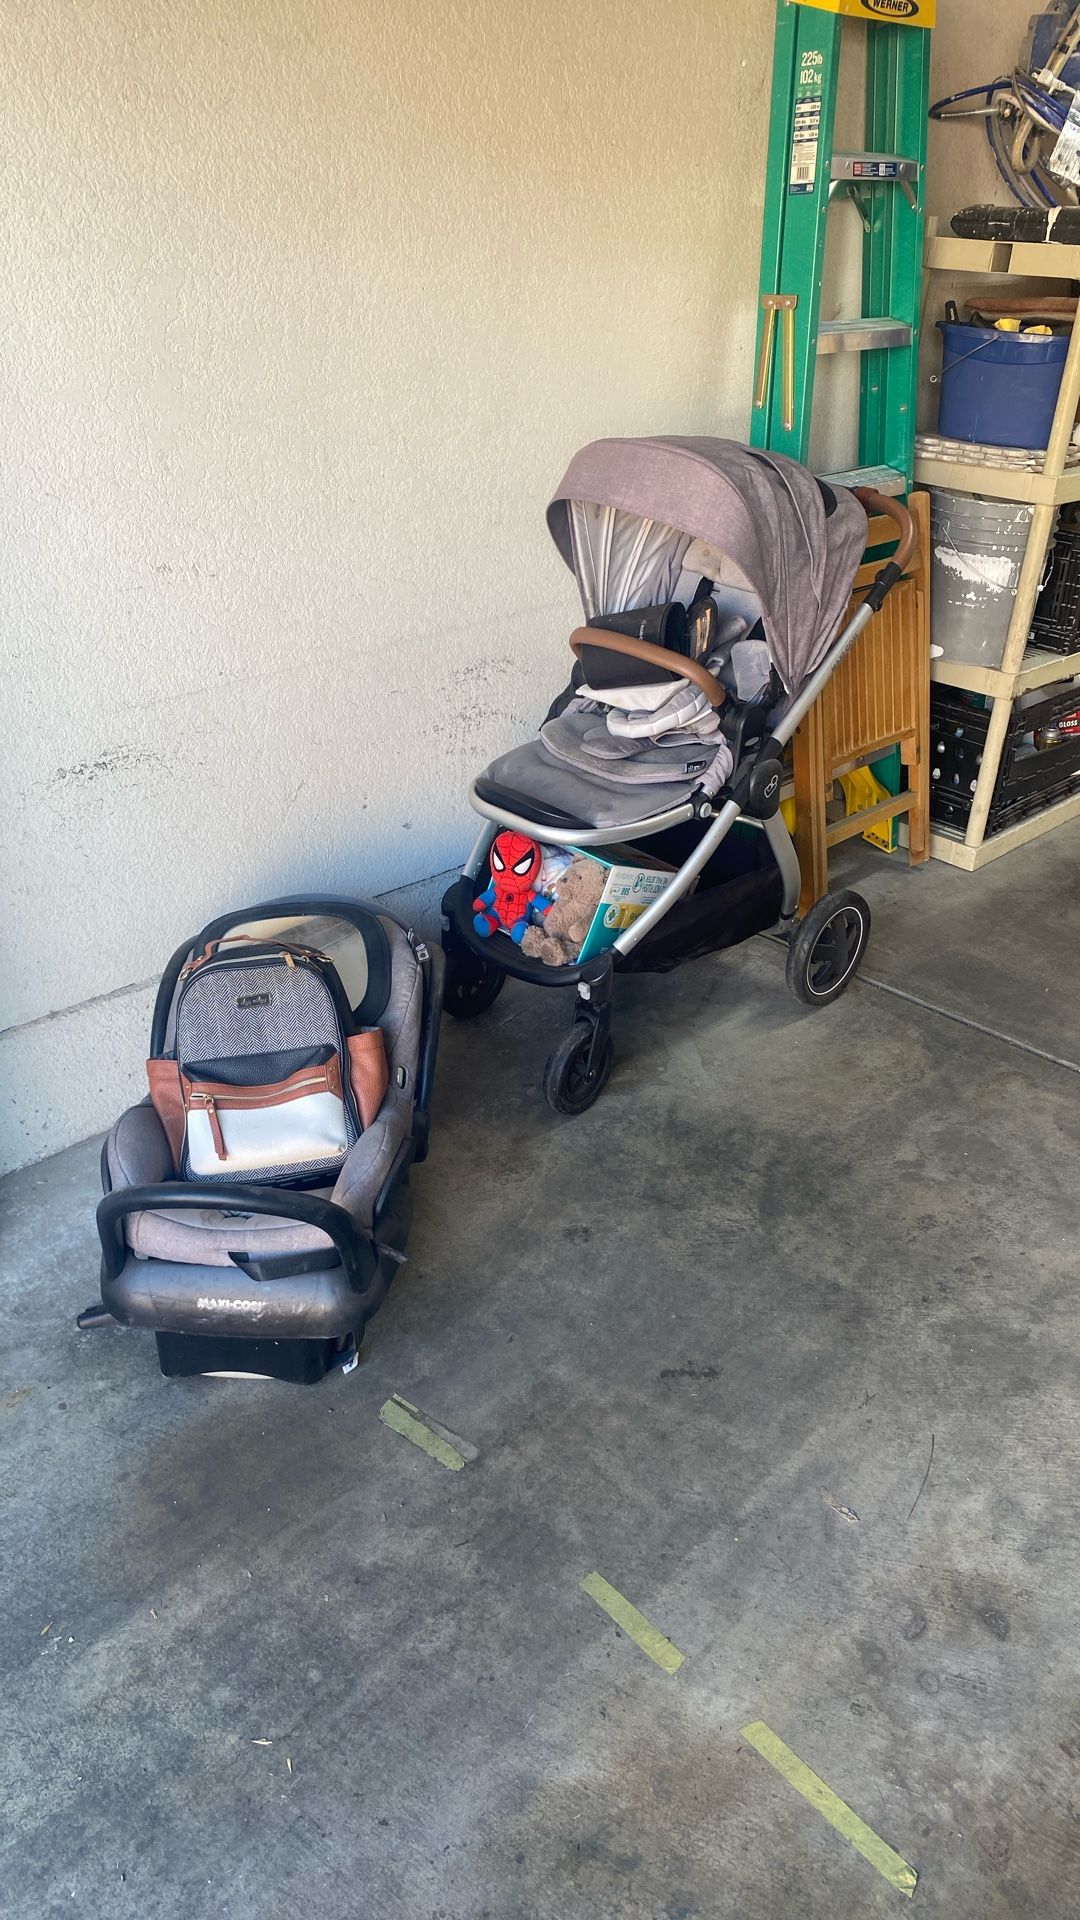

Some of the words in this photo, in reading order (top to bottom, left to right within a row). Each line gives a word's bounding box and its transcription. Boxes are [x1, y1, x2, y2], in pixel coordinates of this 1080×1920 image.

[873, 0, 909, 12] WERNER
[800, 69, 814, 84] 102
[1058, 720, 1078, 728] GLOSS
